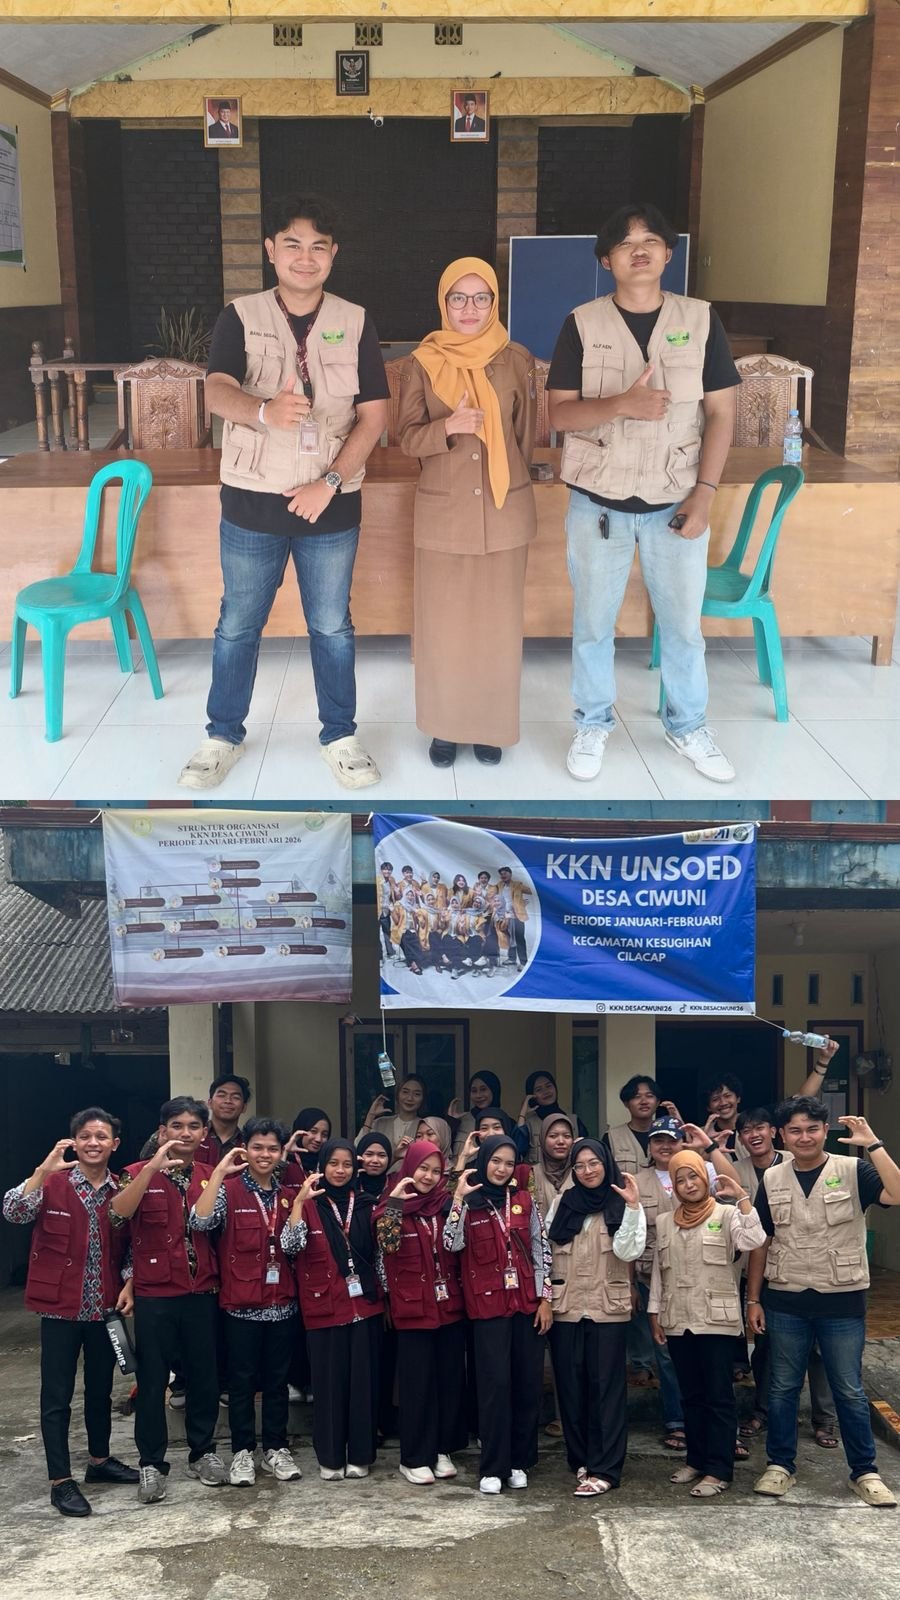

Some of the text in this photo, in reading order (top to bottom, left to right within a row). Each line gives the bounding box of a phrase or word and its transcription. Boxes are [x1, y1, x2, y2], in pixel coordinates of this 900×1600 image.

[177, 823, 280, 832] STRUKTUR ORGANISASI
[158, 836, 302, 847] PERIODE JANUARI-FEBRUARI 2026
[190, 831, 209, 839] KKN
[546, 853, 742, 882] KKN UNSOED
[582, 889, 706, 906] DESA CIWUNI
[563, 915, 722, 928] PERIODE JANUARI-FEBRUARI
[572, 936, 712, 949] KECAMATAN KESUGIHAN
[617, 951, 666, 962] CILACAP
[107, 1328, 126, 1366] SIMPLIFY
